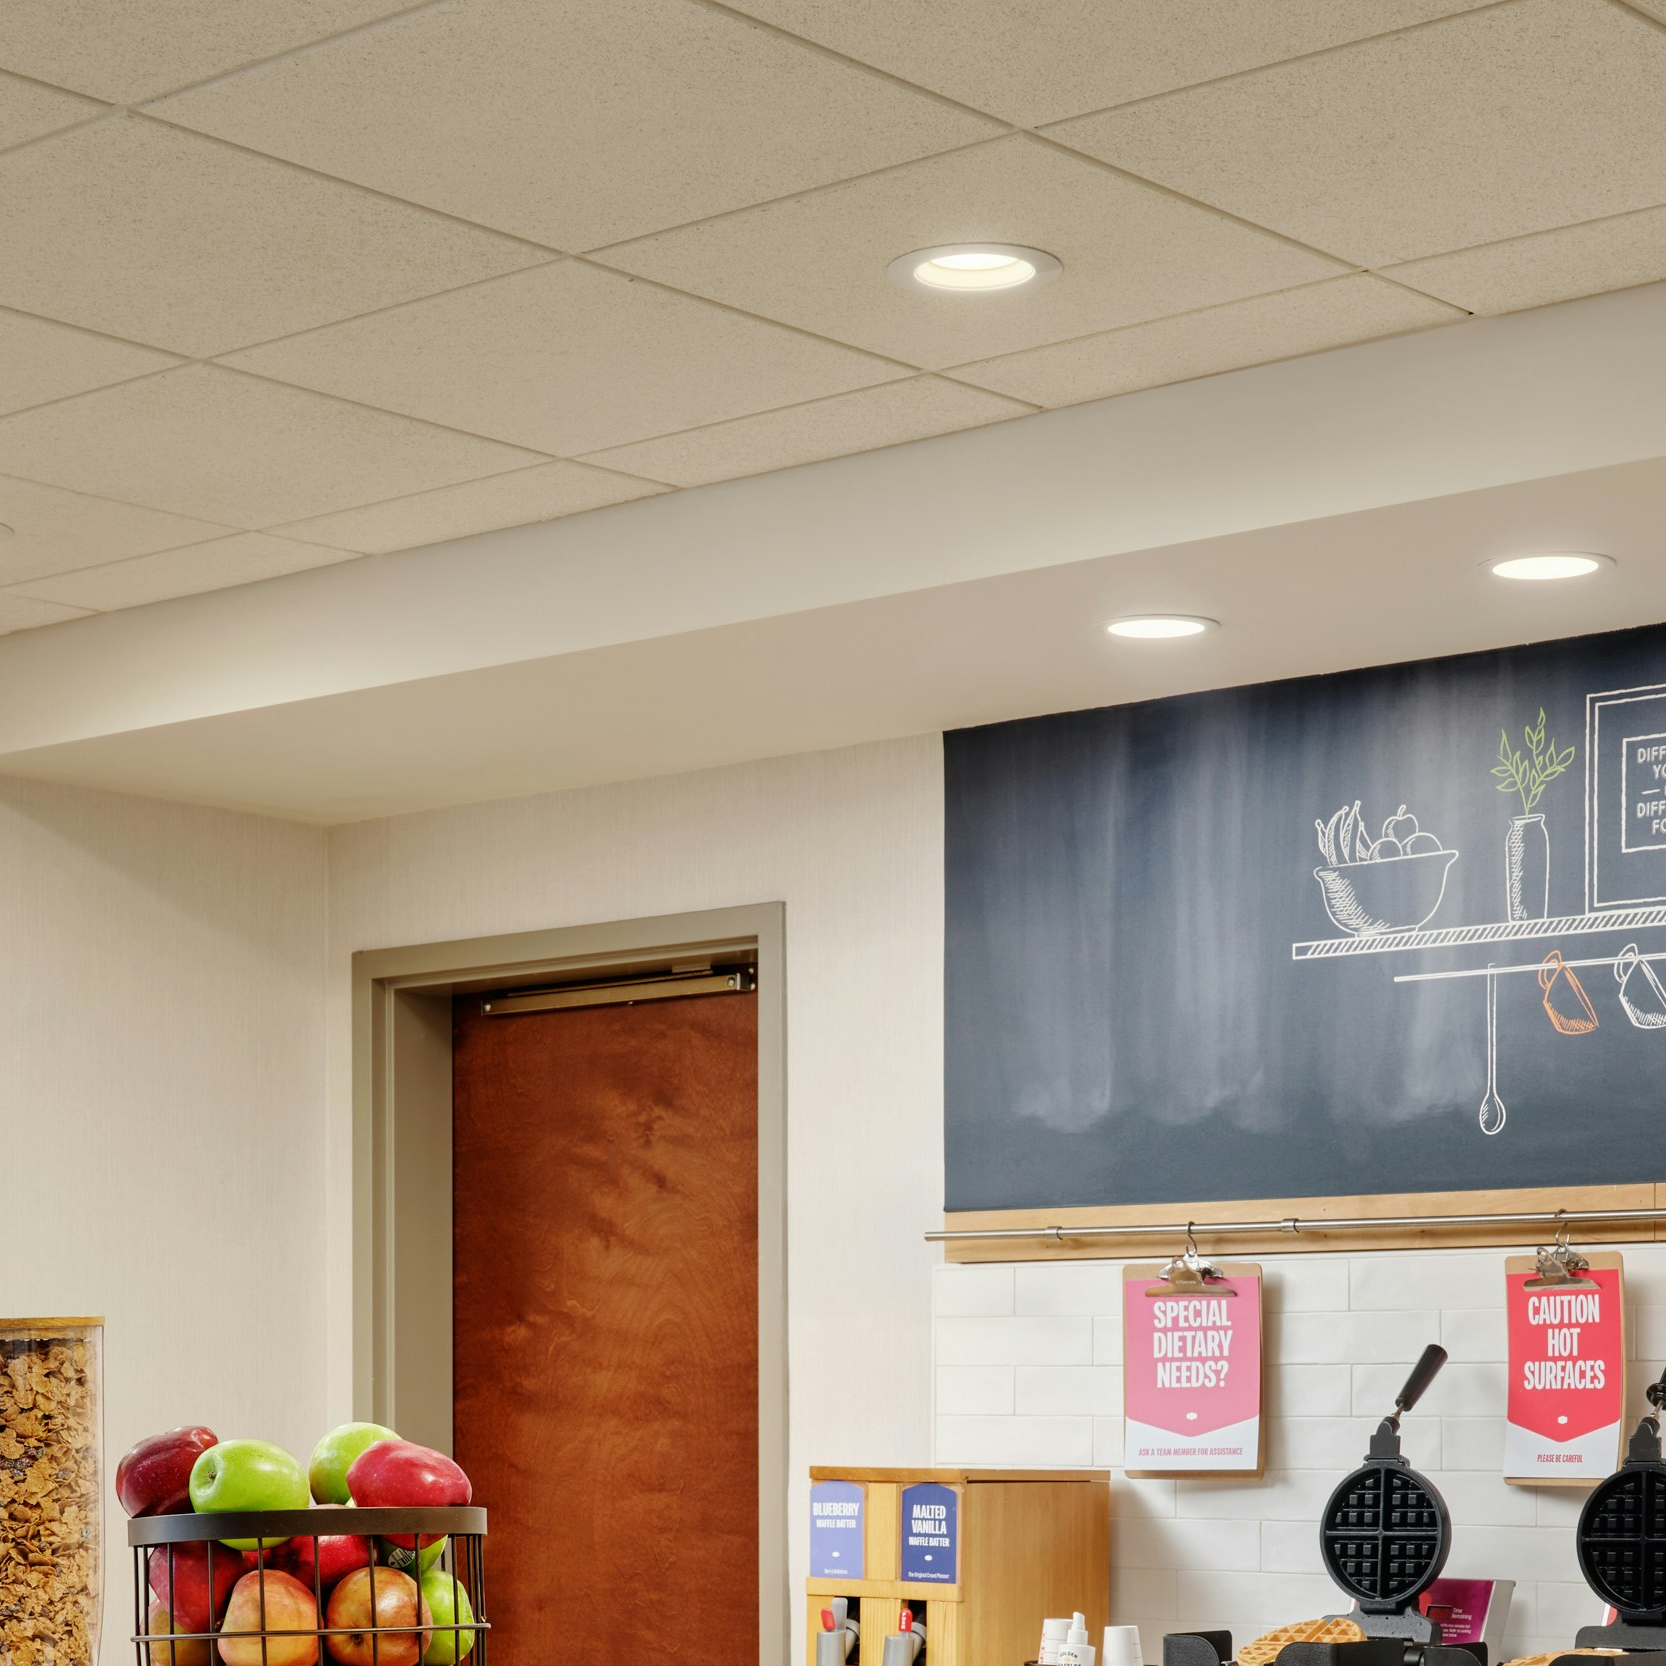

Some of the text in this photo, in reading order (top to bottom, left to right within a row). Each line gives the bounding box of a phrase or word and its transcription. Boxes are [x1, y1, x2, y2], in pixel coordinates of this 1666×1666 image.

[1153, 1300, 1232, 1328] SPECIAL
[1527, 1294, 1600, 1325] CAUTION
[1153, 1330, 1233, 1358] DIETARY
[1547, 1328, 1581, 1357] HOT
[1156, 1360, 1229, 1388] NEEDS?
[1523, 1359, 1606, 1390] SURFACES
[1138, 1449, 1150, 1457] ASK
[1156, 1449, 1172, 1457] TEAM
[1198, 1448, 1209, 1456] FOR
[1209, 1447, 1243, 1456] ASSISTANCE
[1537, 1454, 1583, 1463] PLEASE BE CAREFUL
[813, 1502, 859, 1516] BLUEBERRY
[912, 1504, 946, 1519] MALTED
[816, 1519, 856, 1528] WAFFLE BATTER
[911, 1520, 947, 1534] VANILLA
[908, 1536, 950, 1547] WAFFLE BATTER
